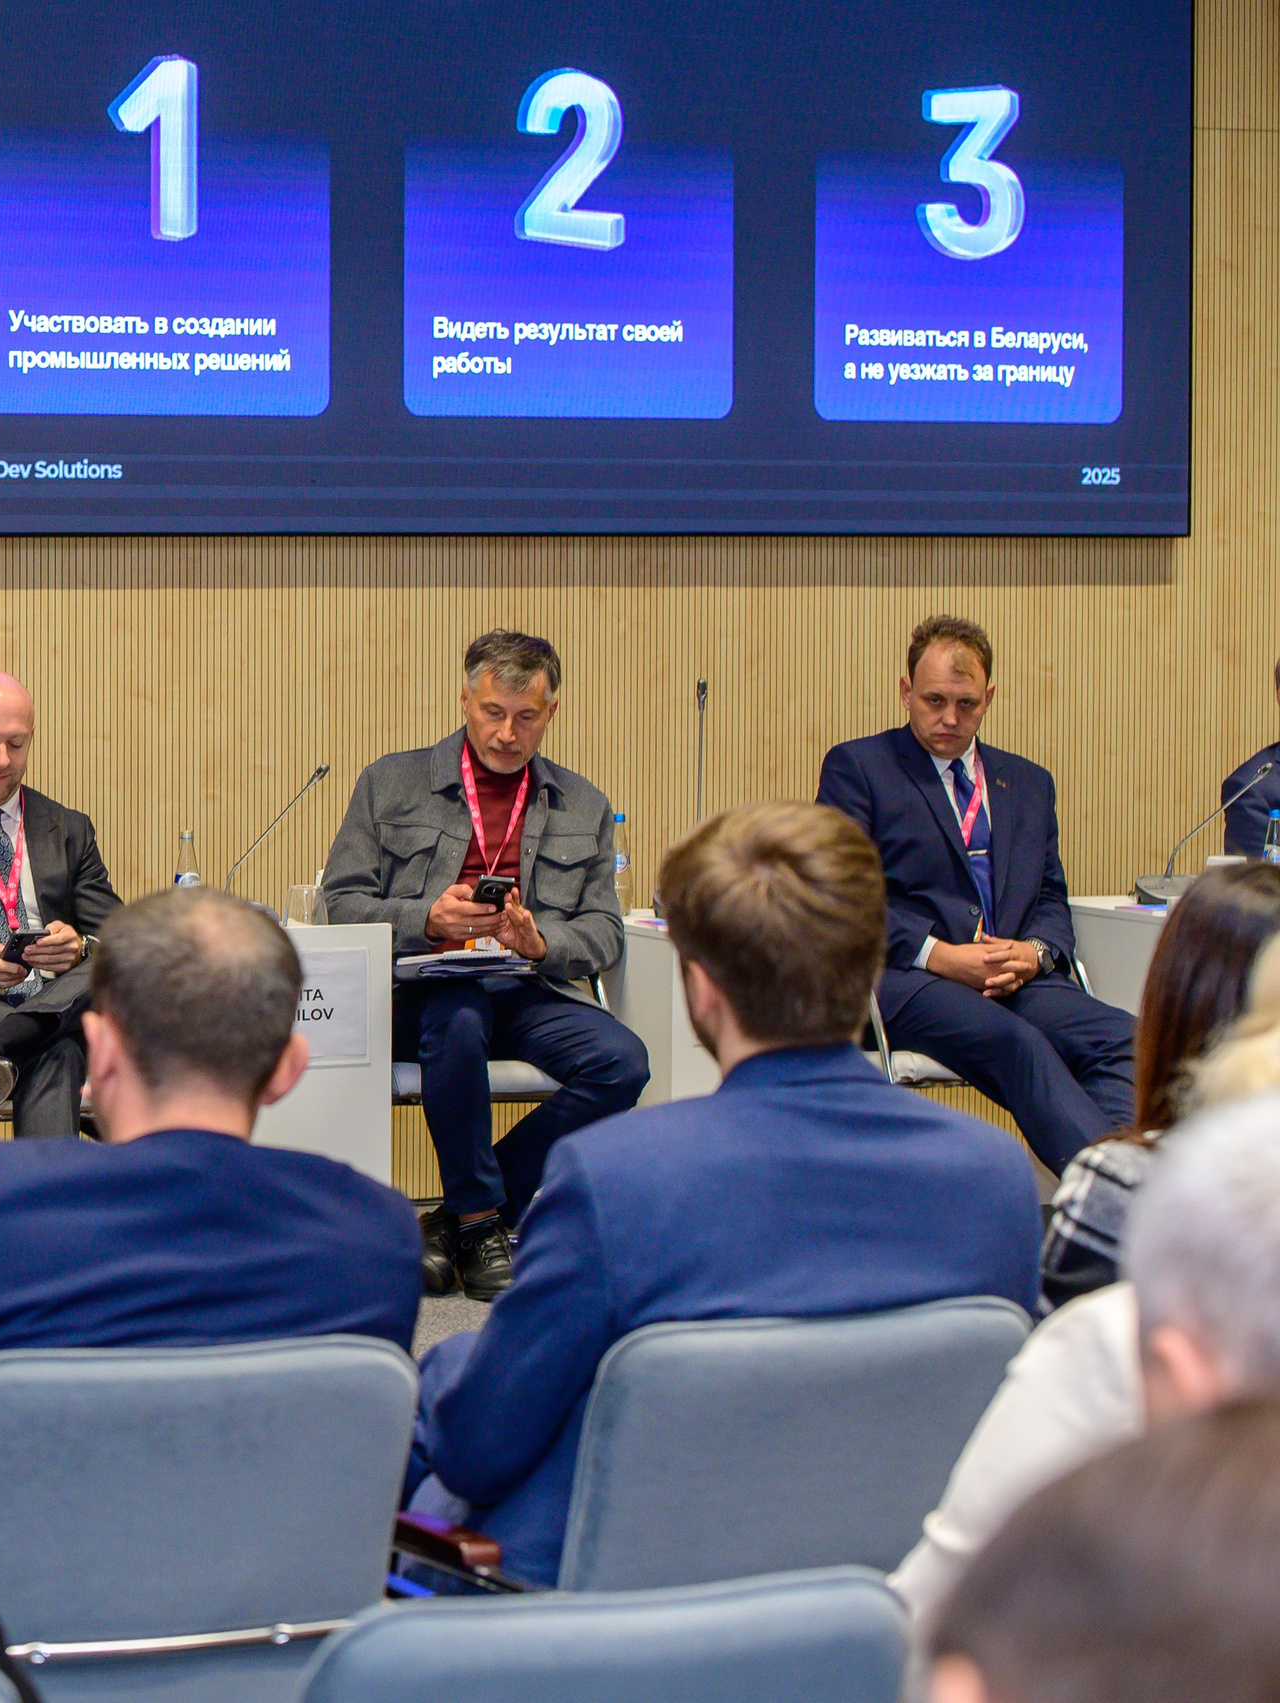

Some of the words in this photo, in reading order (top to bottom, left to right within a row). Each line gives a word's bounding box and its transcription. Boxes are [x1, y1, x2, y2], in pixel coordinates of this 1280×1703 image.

[107, 54, 199, 242] 1
[514, 67, 626, 251] 2
[915, 84, 1026, 261] 3
[8, 309, 149, 334] Участвовать
[154, 316, 168, 334] в
[172, 317, 276, 339] создании
[433, 316, 509, 342] Видеть
[514, 321, 618, 346] результат
[622, 320, 683, 343] своей
[845, 323, 969, 348] Развиваться
[973, 330, 986, 348] в
[991, 326, 1088, 354] Беларуси,
[8, 350, 190, 374] промышленных
[194, 348, 291, 376] решений
[432, 352, 512, 379] работы
[844, 363, 856, 379] а
[860, 362, 884, 380] не
[889, 363, 969, 386] уезжать
[972, 364, 993, 381] за
[997, 365, 1075, 387] границу
[34, 458, 123, 479] Solutions
[1081, 467, 1121, 485] 2025
[300, 988, 324, 1001] ITA
[297, 1007, 334, 1021] ILOV
